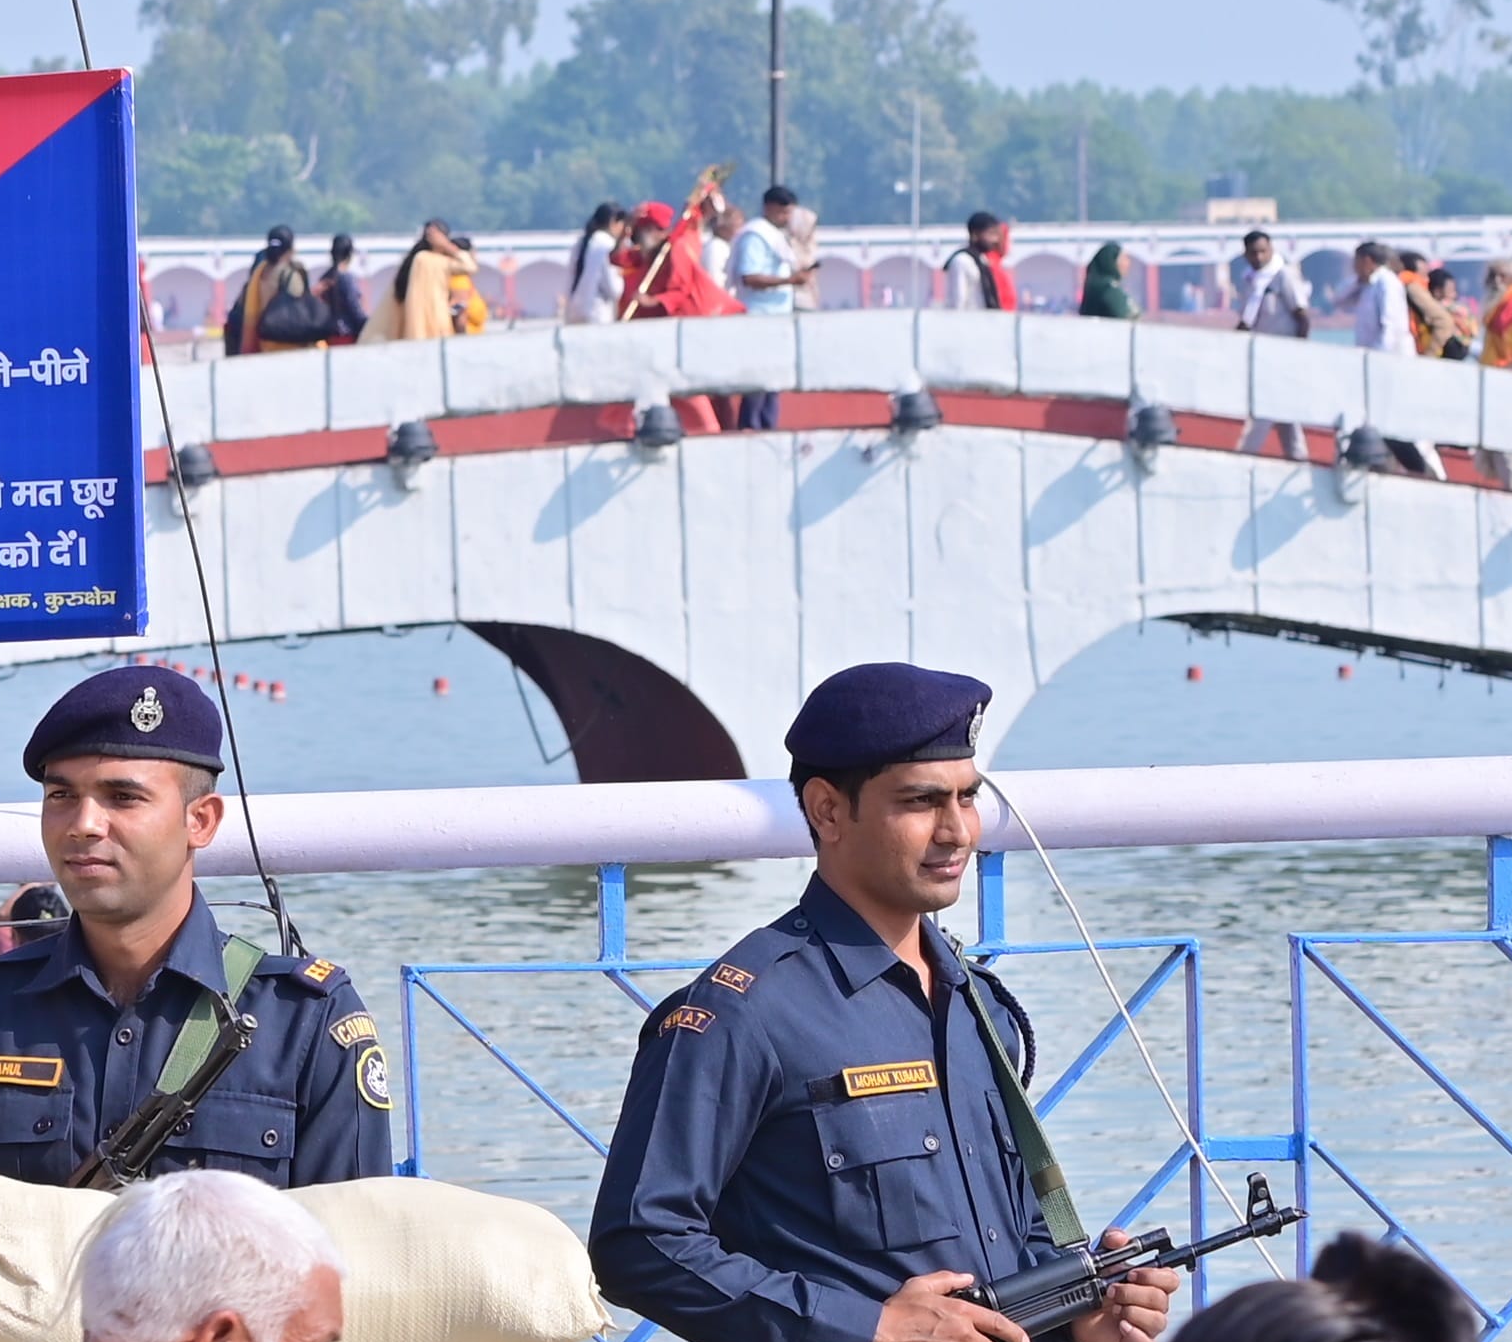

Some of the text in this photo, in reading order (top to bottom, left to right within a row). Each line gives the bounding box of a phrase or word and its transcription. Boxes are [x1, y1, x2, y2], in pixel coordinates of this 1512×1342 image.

[10, 480, 64, 507] मत
[70, 478, 118, 519] छूए
[47, 529, 87, 566] दें।
[44, 585, 117, 616] कुरुक्षेत्र
[663, 1011, 706, 1030] SWAT
[854, 1067, 927, 1088] MOHAN KUMAR
